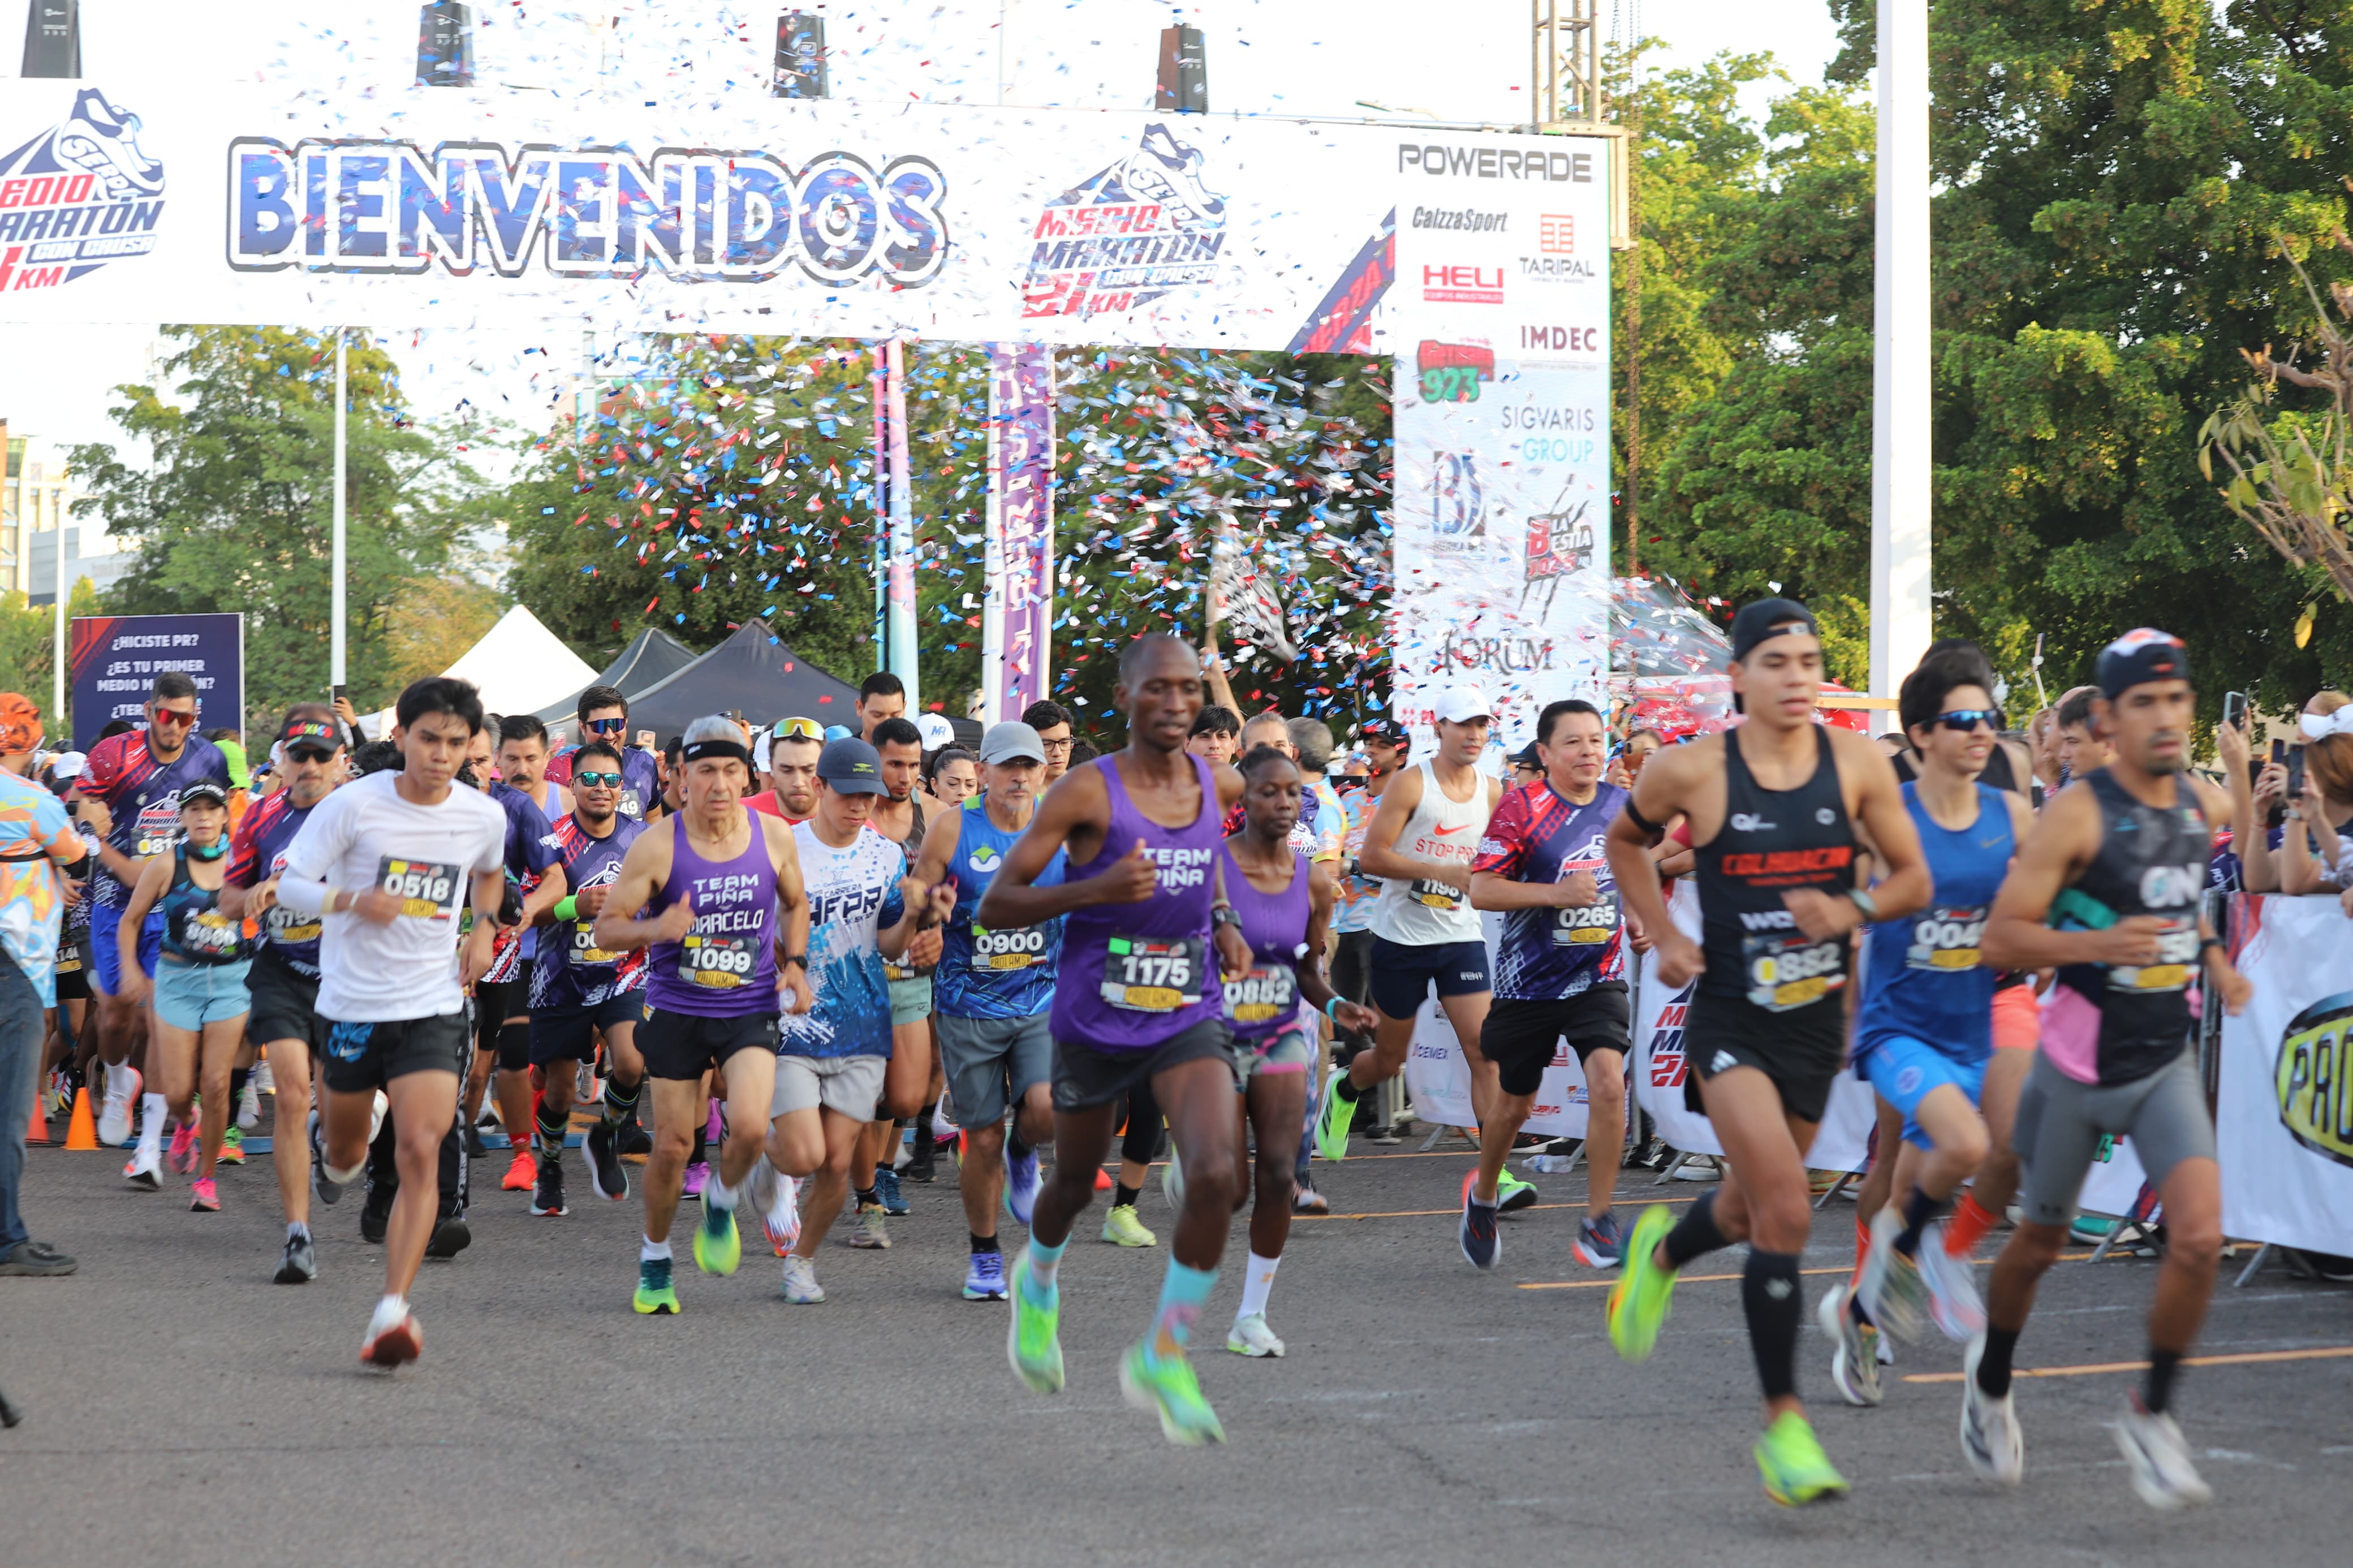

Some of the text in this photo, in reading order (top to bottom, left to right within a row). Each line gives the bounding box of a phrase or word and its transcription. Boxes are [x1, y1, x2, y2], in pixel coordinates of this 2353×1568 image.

[1399, 144, 1592, 183] POWERADE
[0, 174, 95, 208] EDIO
[0, 195, 165, 242] ARATÓN
[228, 136, 947, 290] BIENVENIDOS
[1413, 205, 1509, 233] CalzzaSport
[80, 234, 154, 258] CAUSA
[13, 266, 64, 291] KM
[1423, 265, 1503, 288] HELI
[1519, 257, 1596, 277] TARIPAL
[1521, 325, 1597, 352] IMDEC
[1501, 405, 1594, 431] SIGVARIS
[1523, 438, 1594, 463] GROUP
[111, 634, 199, 651] ¿HICISTE PR?
[1443, 629, 1557, 676] FORUM
[106, 659, 205, 676] ¿ES TU PRIMER
[97, 679, 140, 692] MEDIO
[1142, 848, 1212, 866] TEAM
[1415, 838, 1455, 858] STOP
[383, 872, 451, 902] 0518
[692, 874, 759, 893] TEAM
[824, 883, 863, 898] CARRERA
[699, 887, 753, 908] PIÑA
[686, 908, 764, 934] MARCELO
[1559, 905, 1617, 928] 0265
[976, 931, 1044, 954] 0900
[689, 948, 751, 973] 1099
[1122, 955, 1190, 987] 1175
